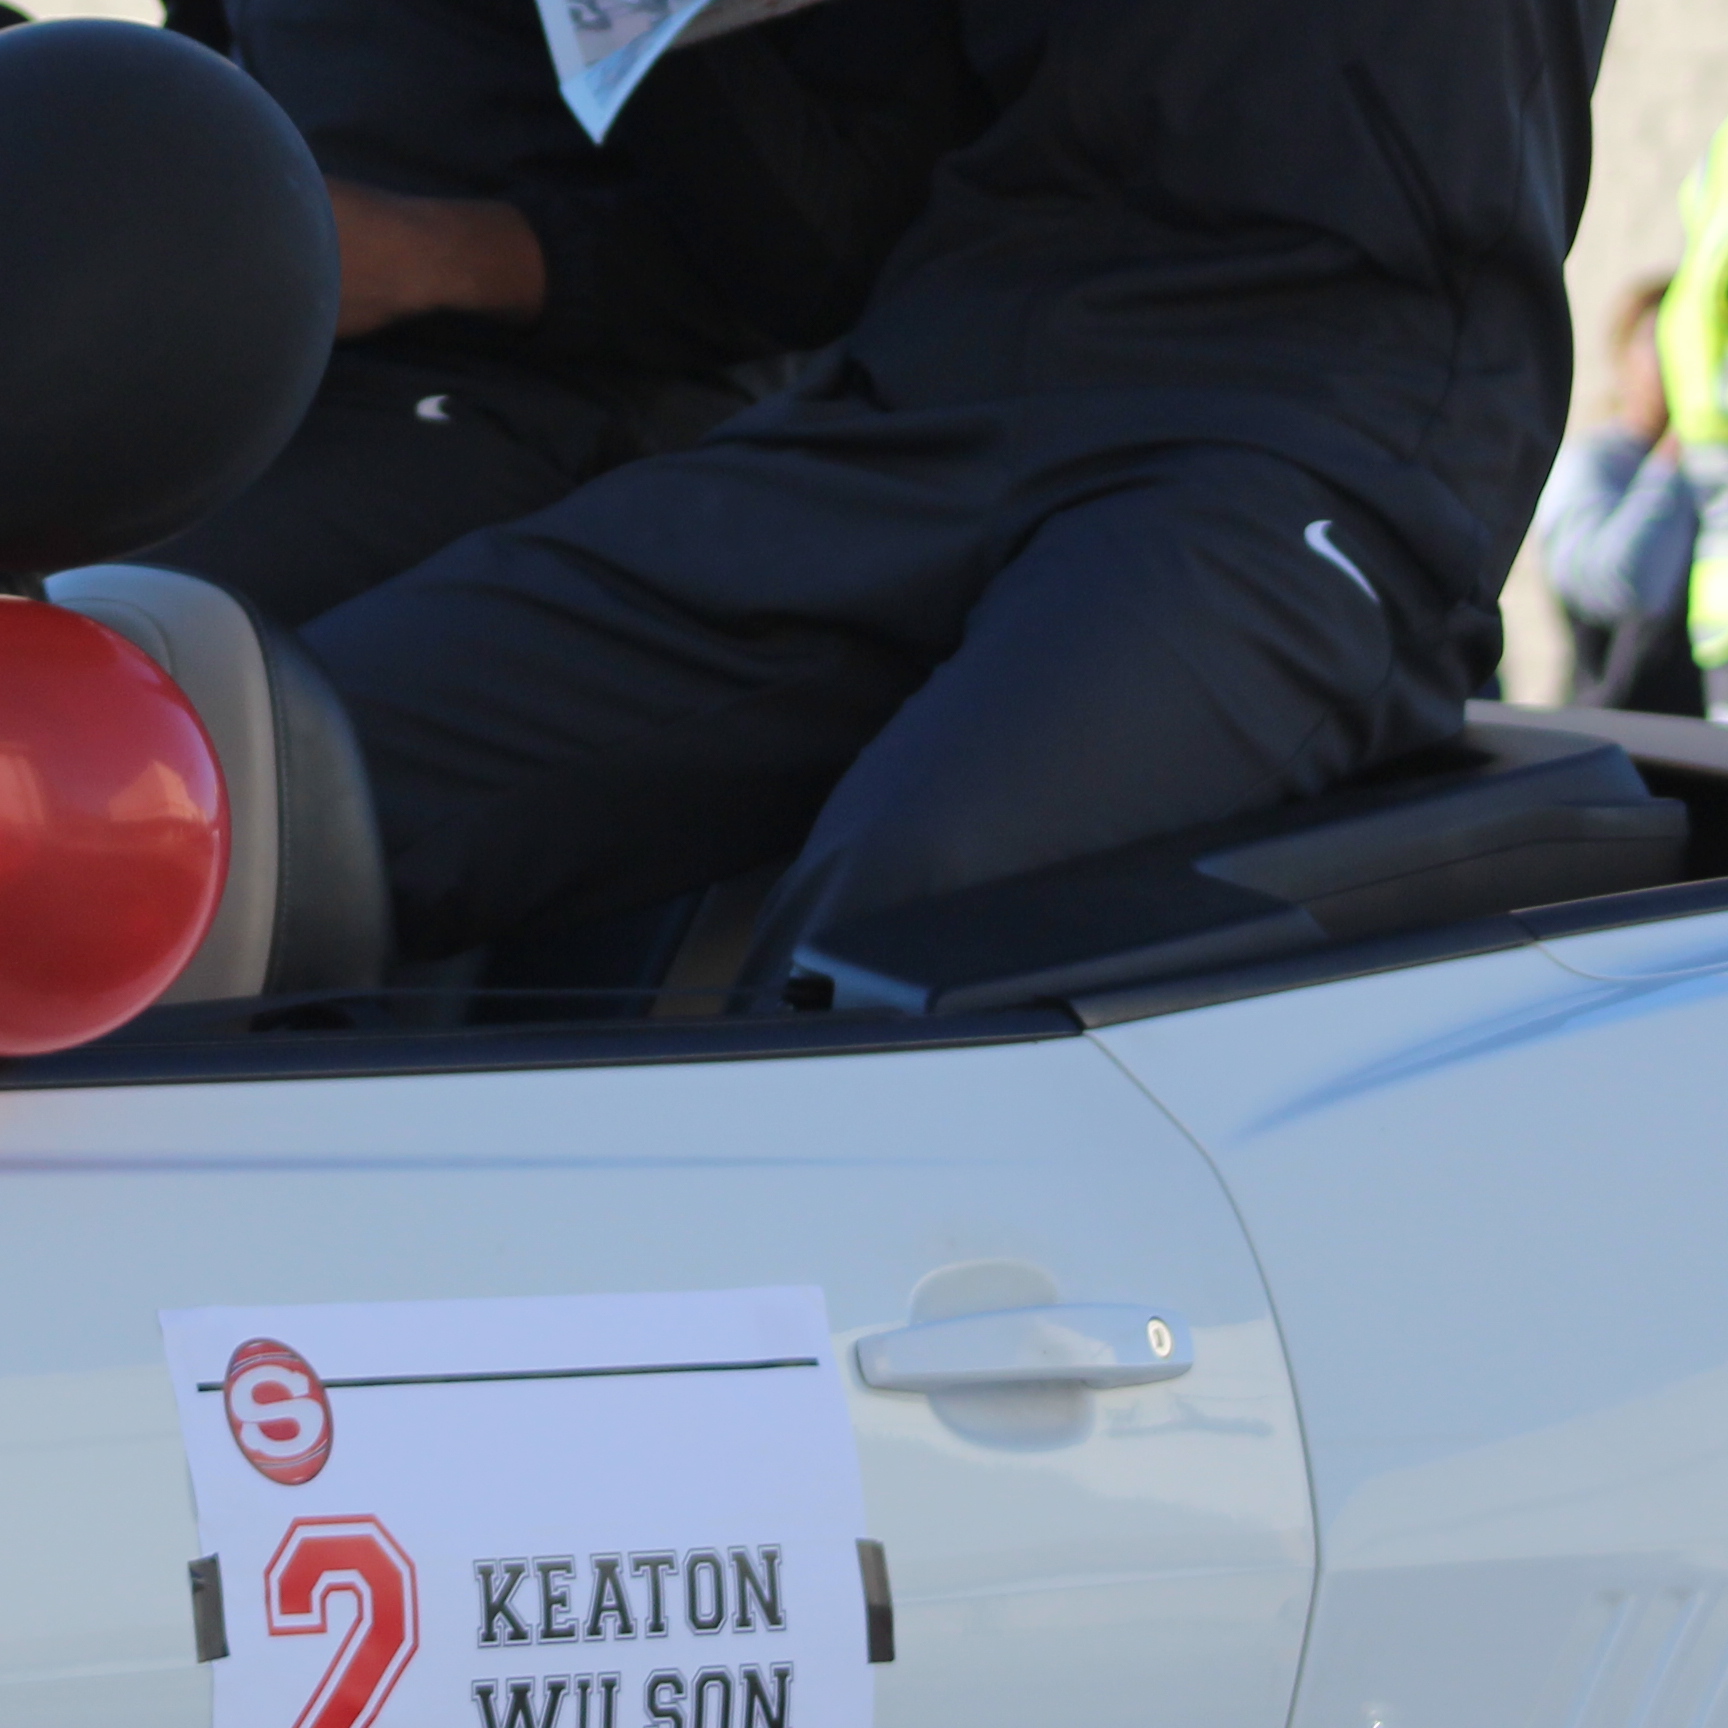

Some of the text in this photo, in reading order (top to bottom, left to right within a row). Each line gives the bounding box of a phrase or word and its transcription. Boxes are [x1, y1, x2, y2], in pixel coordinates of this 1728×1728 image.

[229, 1364, 325, 1459] S
[264, 1513, 420, 1728] 2
[472, 1544, 786, 1649] KEATON
